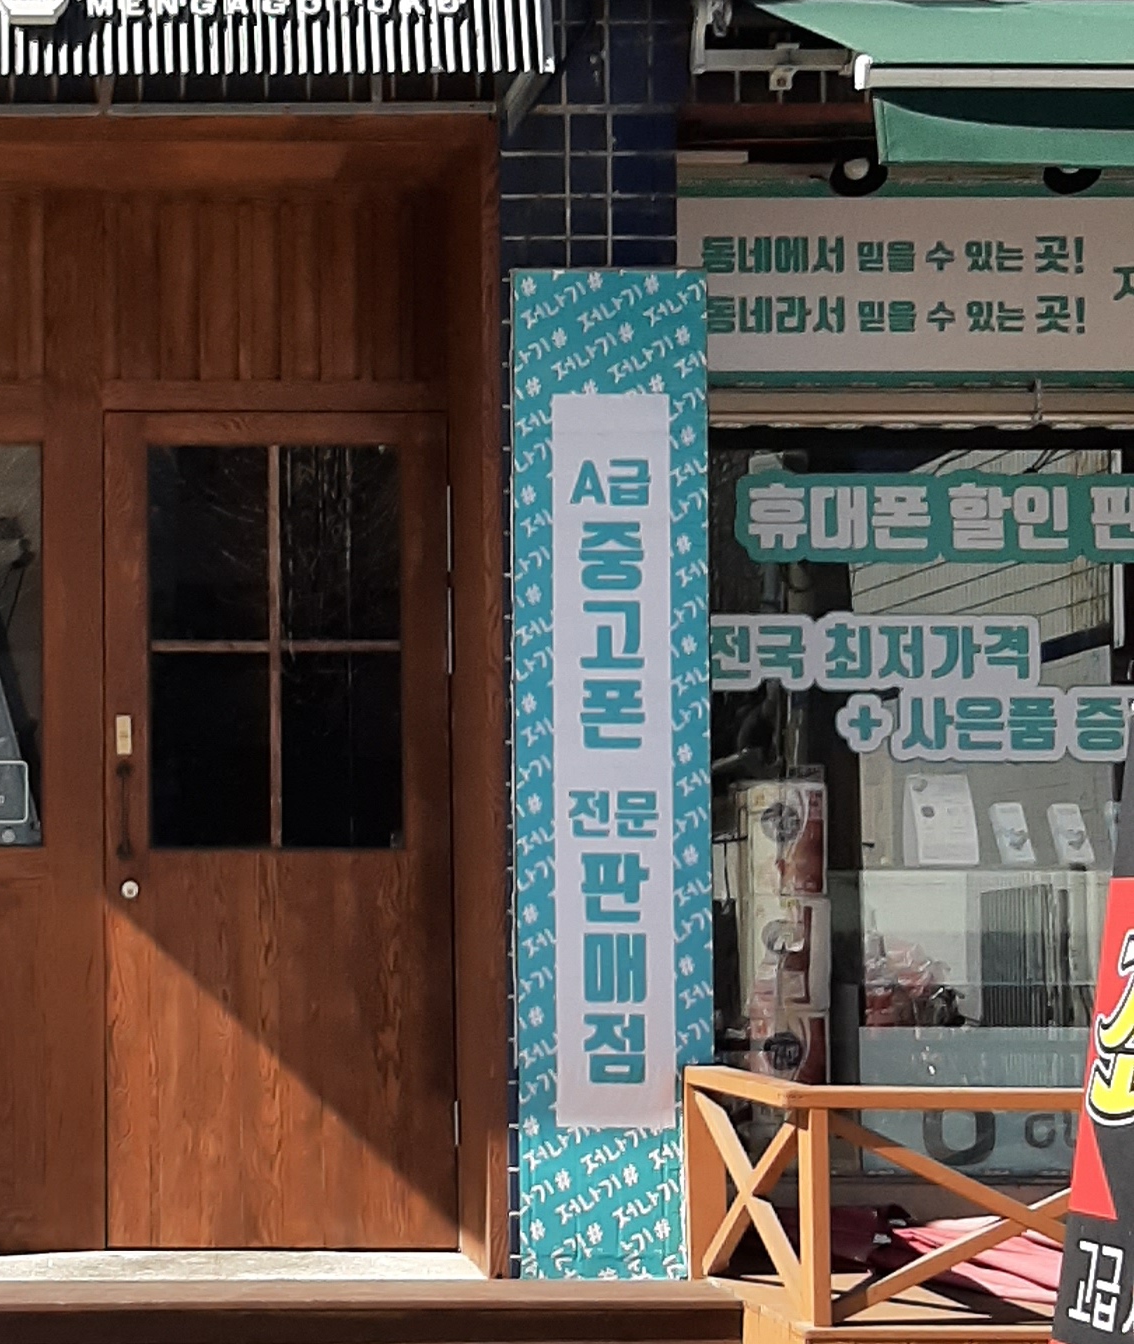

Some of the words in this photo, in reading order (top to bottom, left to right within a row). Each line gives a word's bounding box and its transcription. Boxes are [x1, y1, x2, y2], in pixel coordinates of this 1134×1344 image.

[701, 235, 845, 274] 동네에서
[857, 241, 915, 273] 믿을
[925, 241, 955, 272] 수
[966, 240, 1025, 273] 있는
[1035, 235, 1084, 274] 곳!
[706, 295, 845, 334] 동네라서
[857, 301, 916, 333] 믿을
[926, 301, 956, 333] 수
[967, 300, 1026, 333] 있는
[1036, 295, 1086, 334] 곳!
[570, 459, 651, 506] A급
[748, 481, 932, 551] 휴대폰
[949, 481, 1069, 551] 할인
[711, 624, 806, 681] 전국
[824, 622, 1031, 681] 최저가격
[568, 789, 660, 839] 전문
